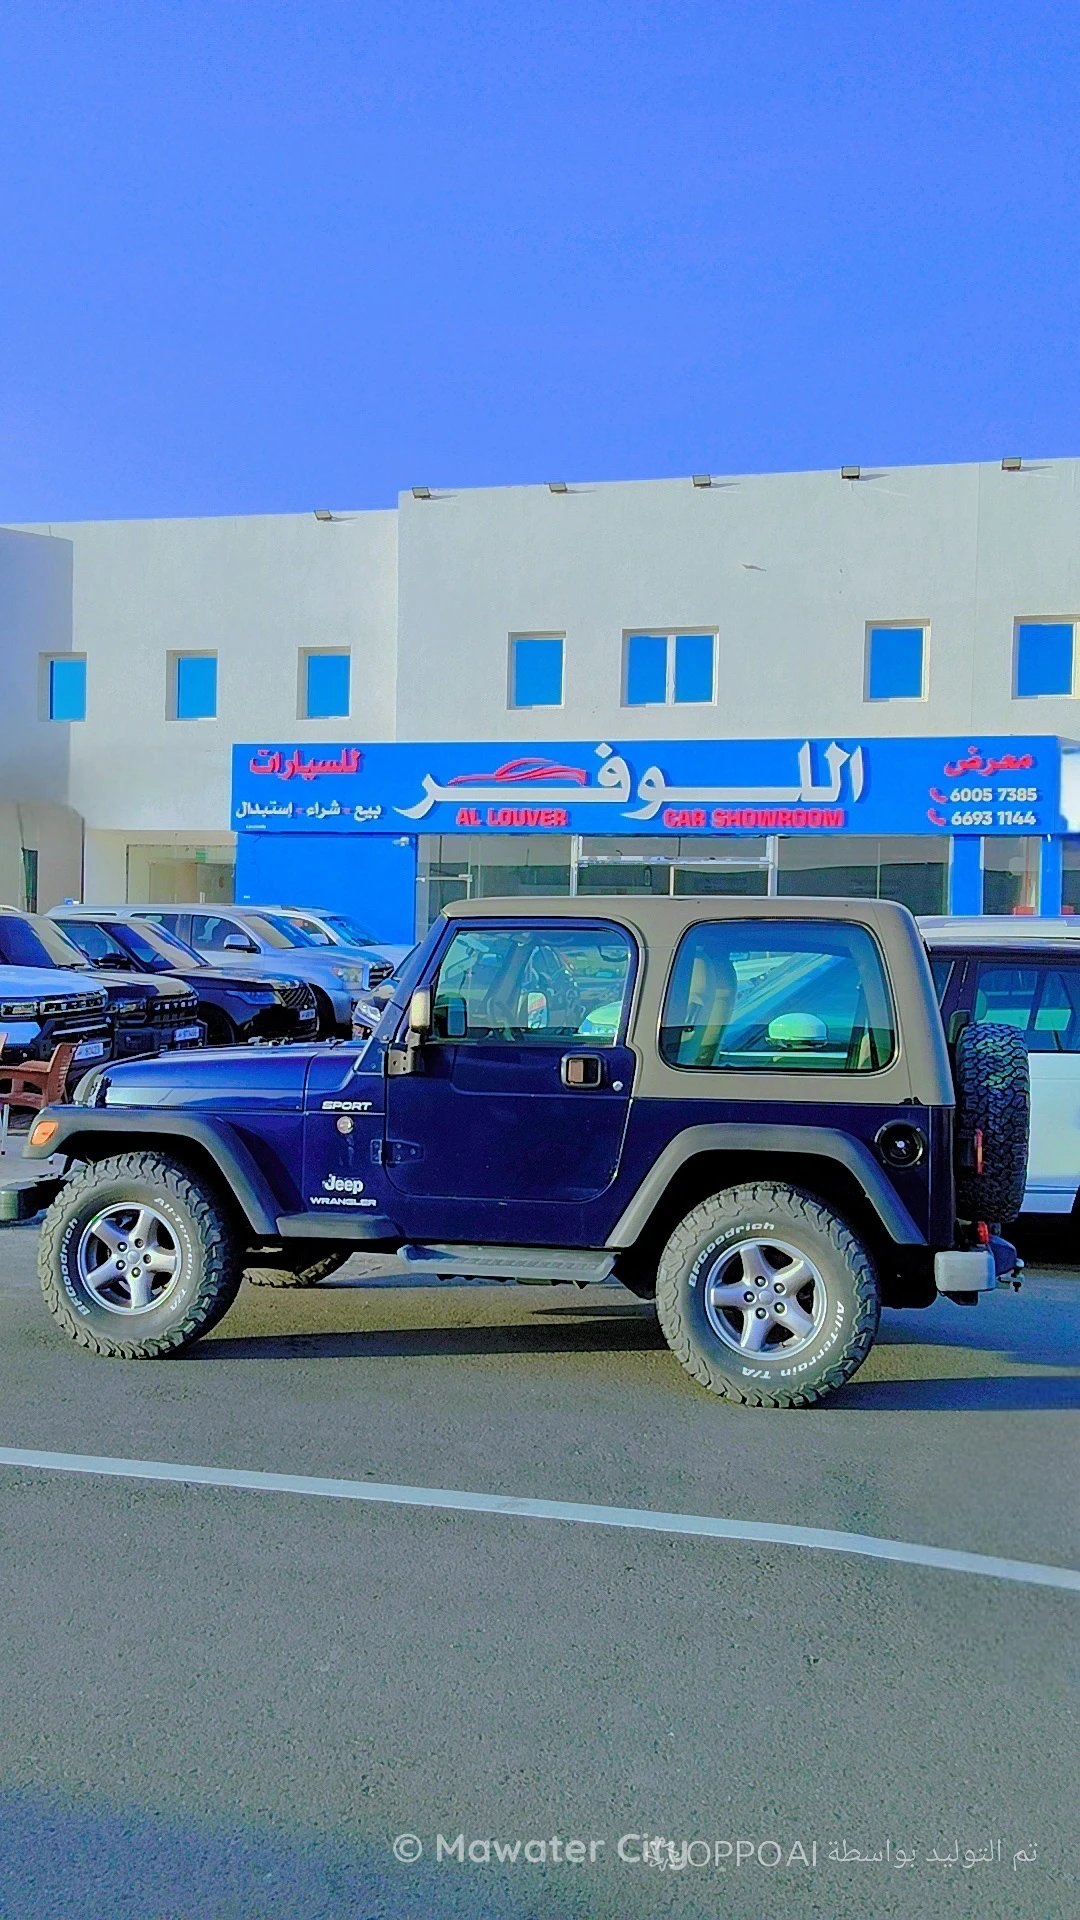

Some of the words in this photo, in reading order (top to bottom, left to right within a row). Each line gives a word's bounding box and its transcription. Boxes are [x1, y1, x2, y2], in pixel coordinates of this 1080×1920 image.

[250, 748, 361, 780] للسيارات
[944, 746, 1033, 776] معرض
[392, 741, 864, 820] اللوفر
[950, 787, 993, 802] 6005
[997, 787, 1038, 802] 7385
[235, 800, 293, 818] إستبدال
[306, 799, 341, 819] شراء
[353, 803, 382, 822] بيع
[456, 808, 482, 826] AL
[487, 807, 569, 828] LOUVER
[664, 808, 706, 828] CAR
[711, 808, 845, 828] SHOWROOM
[951, 810, 993, 826] 6693
[997, 810, 1037, 826] 1144
[321, 1101, 373, 1111] SPORT
[322, 1173, 364, 1195] Jeep
[309, 1196, 377, 1207] WRANGLER
[688, 1222, 775, 1288] BFGoodrich
[60, 1217, 92, 1316] BFGoodrich
[780, 1300, 845, 1377] All-Terrain
[741, 1366, 772, 1380] T/A
